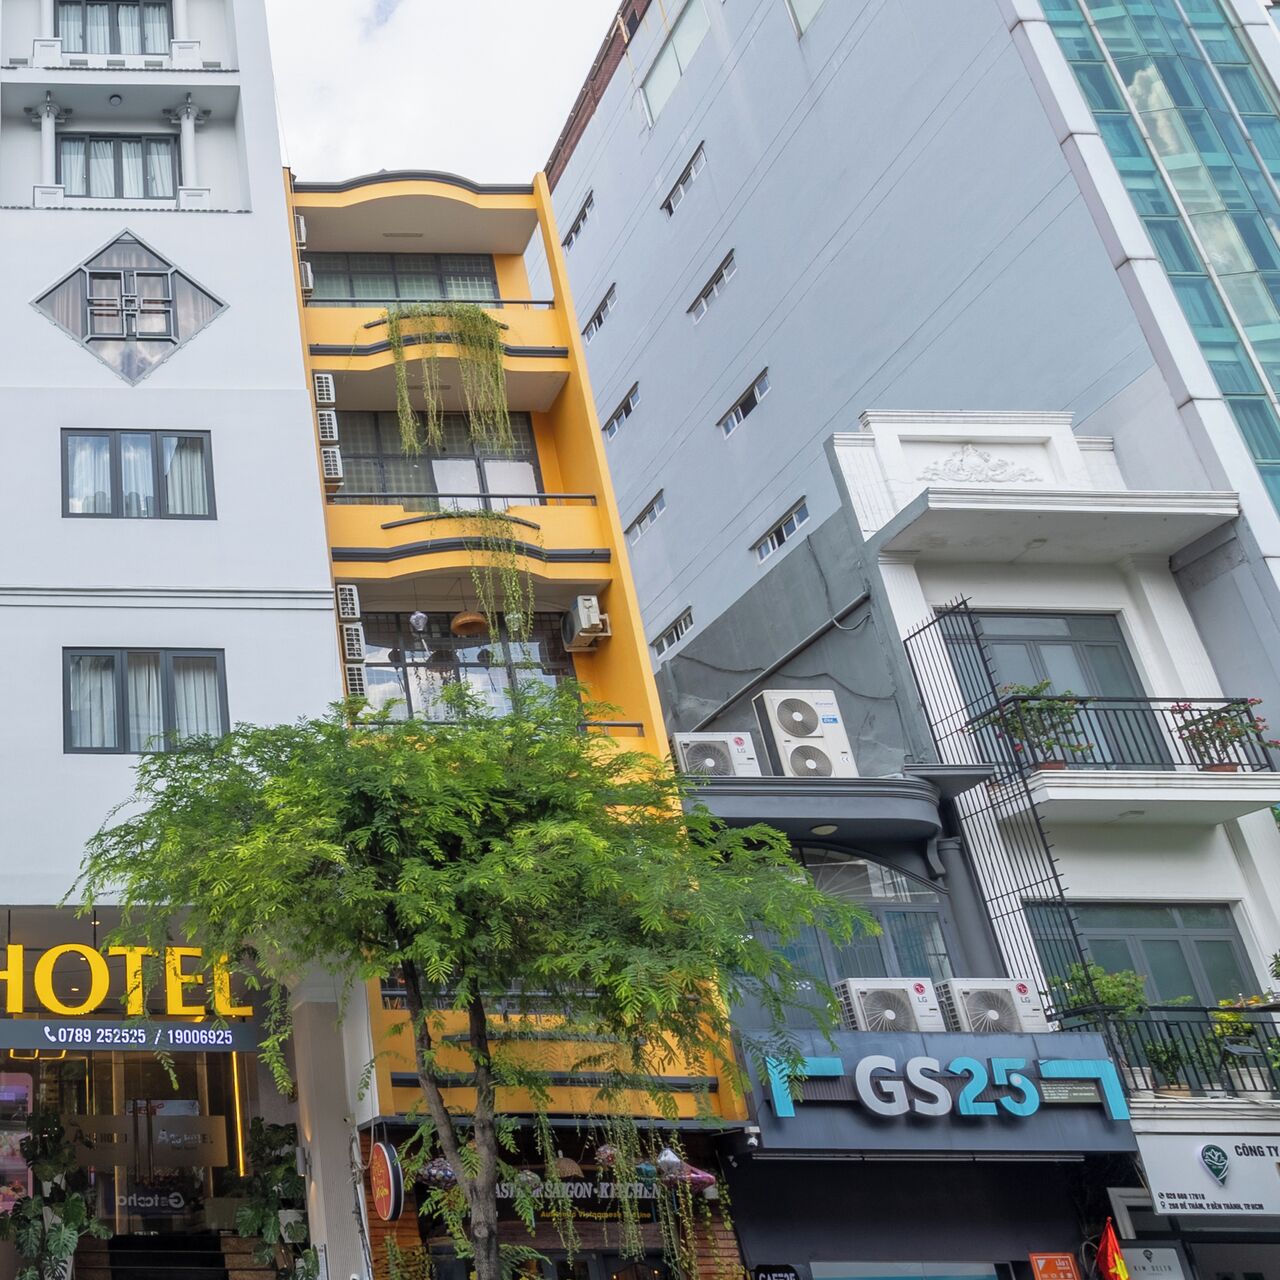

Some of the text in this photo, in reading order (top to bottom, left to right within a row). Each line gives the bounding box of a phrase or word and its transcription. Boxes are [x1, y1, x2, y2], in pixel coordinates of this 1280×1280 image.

[1021, 996, 1031, 1004] LG
[58, 1027, 92, 1044] 0789
[97, 1028, 146, 1044] 252525
[168, 1029, 233, 1045] 19006925
[854, 1055, 1040, 1117] GS25
[1234, 1143, 1280, 1157] CÔNG TY
[599, 1182, 660, 1199] KICHEN
